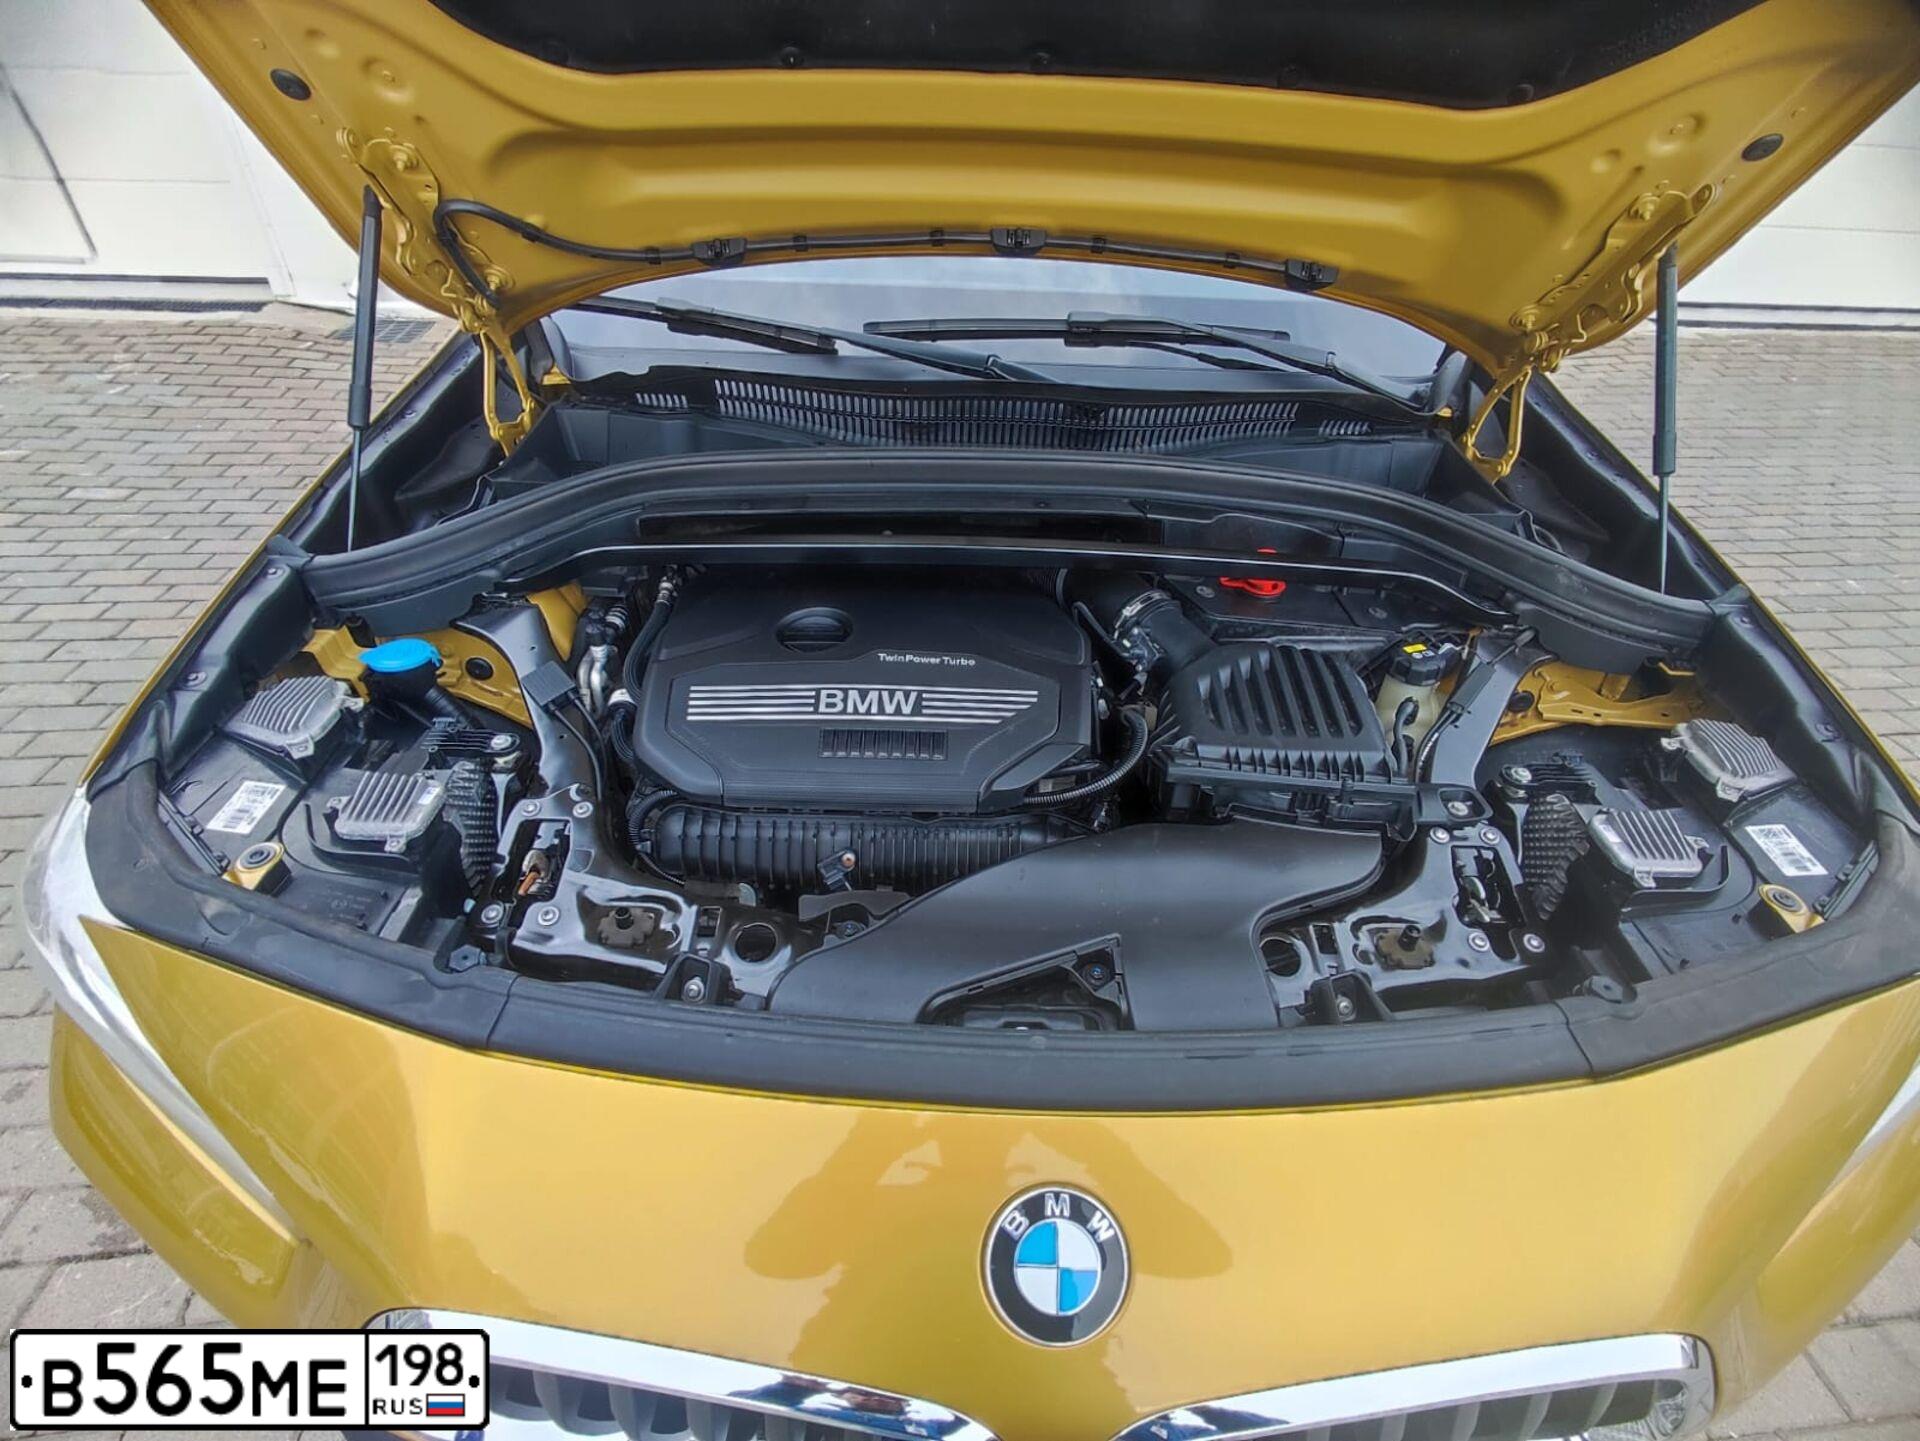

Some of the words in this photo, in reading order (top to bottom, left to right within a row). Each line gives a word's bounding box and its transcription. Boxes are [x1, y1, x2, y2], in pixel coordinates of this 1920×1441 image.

[942, 656, 976, 666] Turbo
[818, 689, 918, 715] BMW
[1001, 1193, 1115, 1242] BMW
